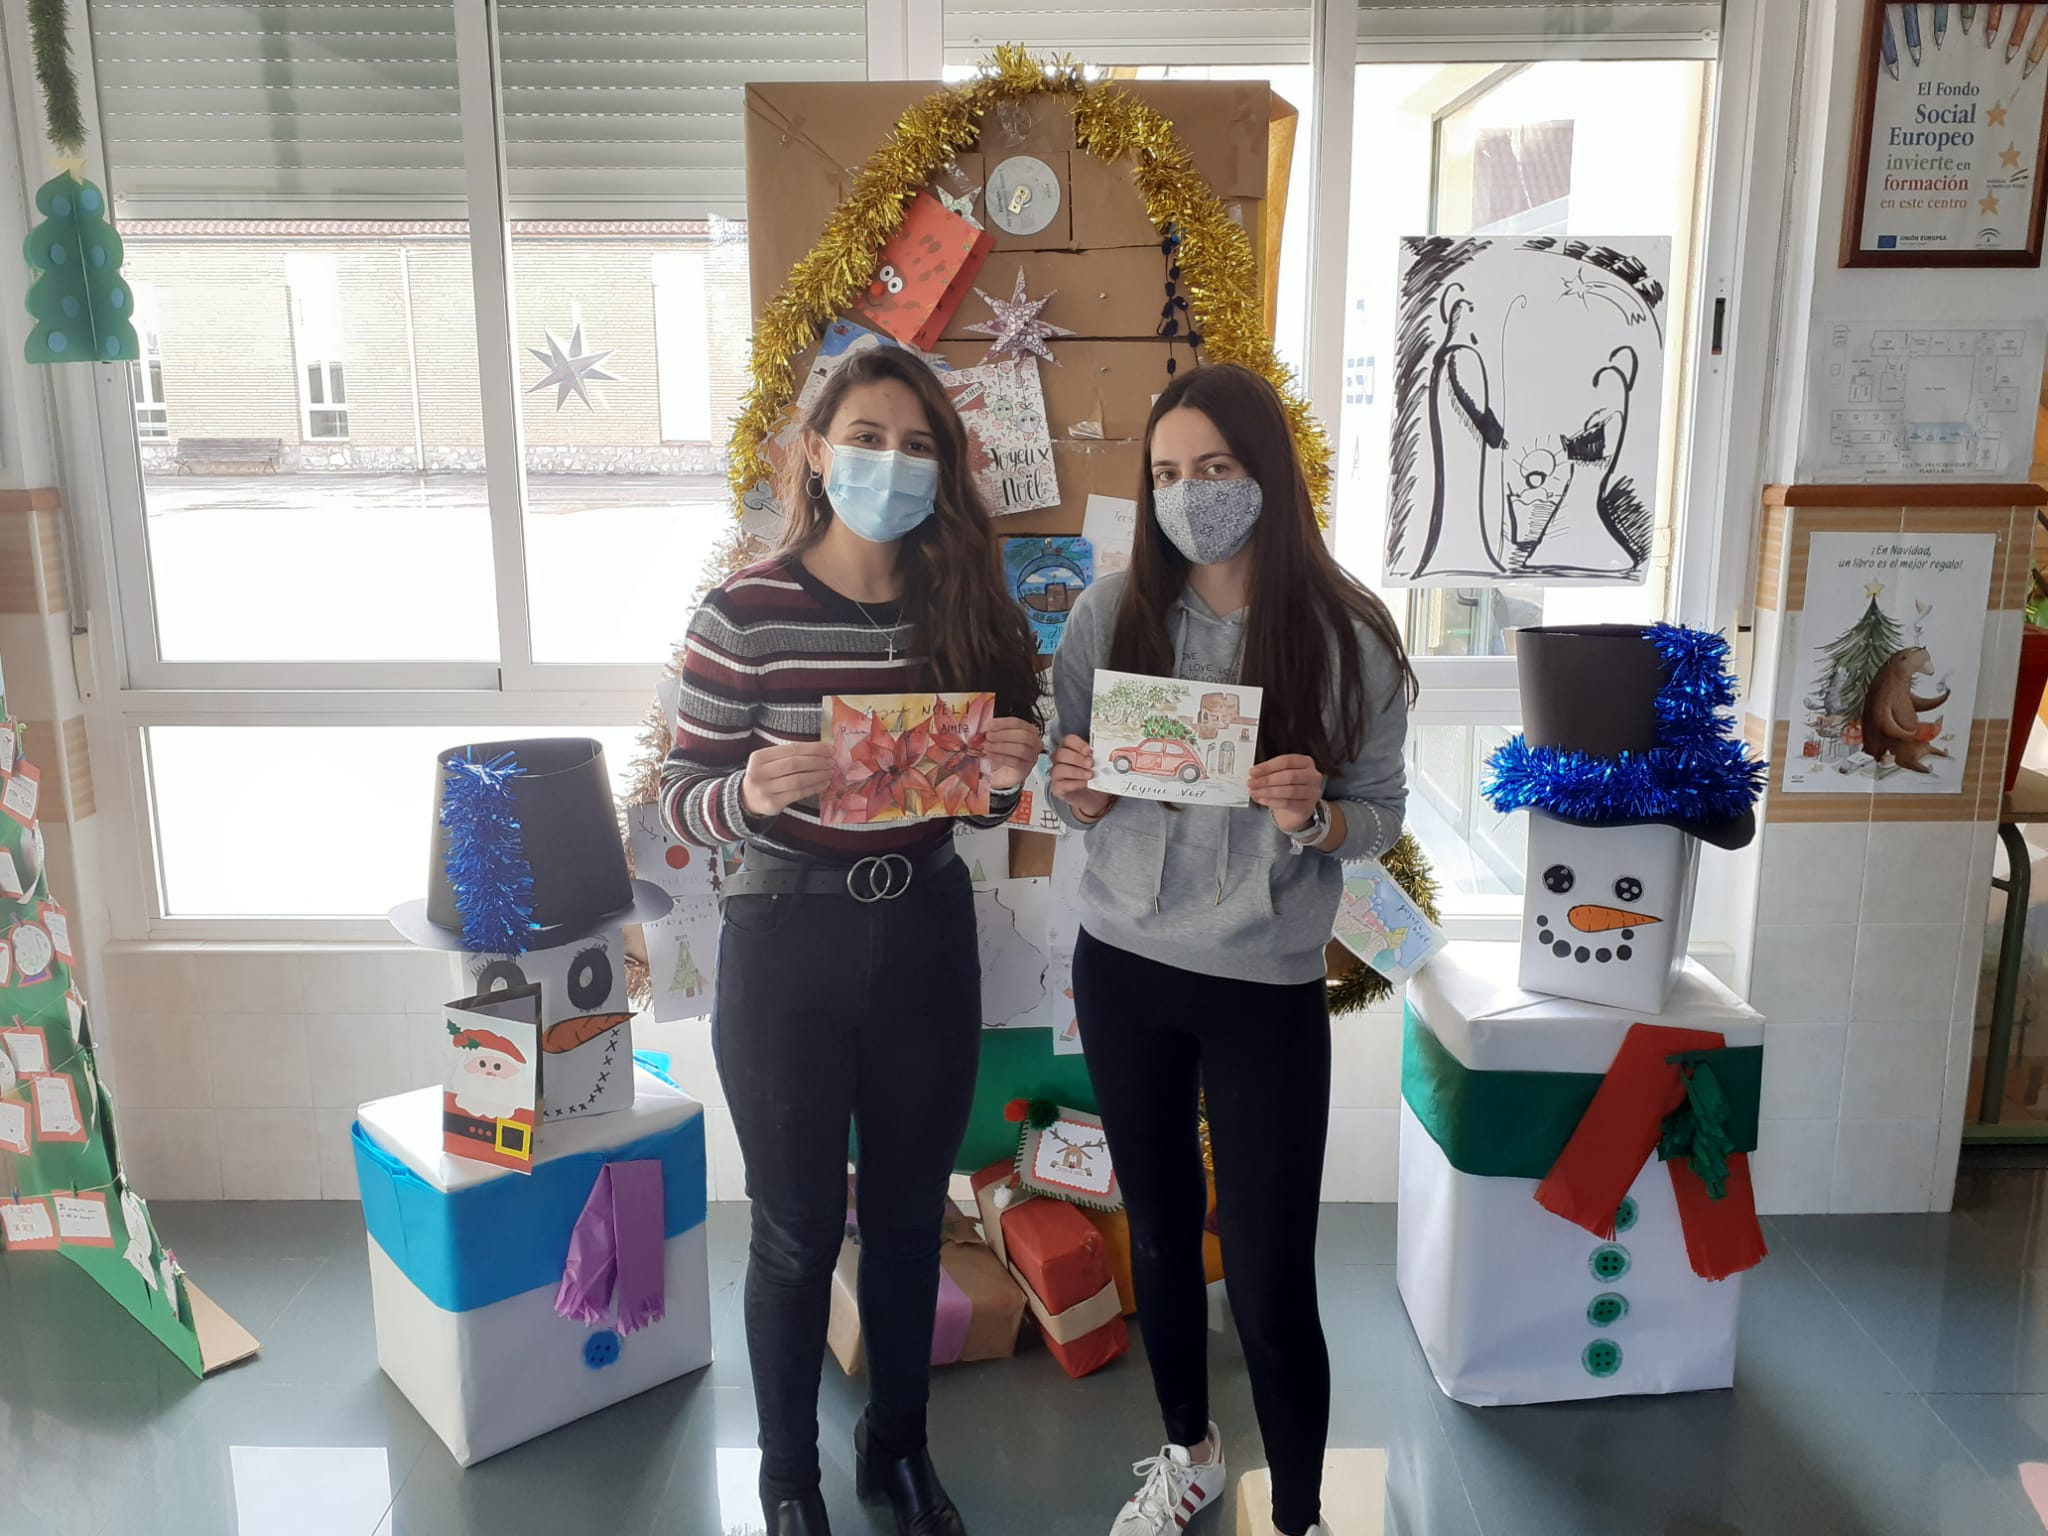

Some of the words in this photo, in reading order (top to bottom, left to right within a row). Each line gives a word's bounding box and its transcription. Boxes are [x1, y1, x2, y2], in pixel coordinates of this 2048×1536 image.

[1917, 82, 1931, 96] El
[1936, 82, 1980, 97] Fondo
[1915, 103, 1977, 124] Social
[1888, 127, 1975, 152] Europeo
[1886, 153, 1954, 171] invierte
[1956, 161, 1971, 170] en
[1883, 174, 1969, 192] formación
[1880, 199, 1895, 209] en
[1899, 198, 1924, 209] este
[1927, 198, 1968, 209] centro
[989, 447, 1050, 473] Joyeux
[1871, 545, 1888, 556] ¡En
[1890, 544, 1932, 557] Navidad,
[1838, 560, 1851, 568] un
[1853, 558, 1875, 569] libro
[1877, 560, 1887, 569] es
[1889, 558, 1898, 569] el
[1900, 559, 1927, 570] mejor
[1929, 560, 1963, 572] regalo!
[1189, 663, 1214, 672] LOVE
